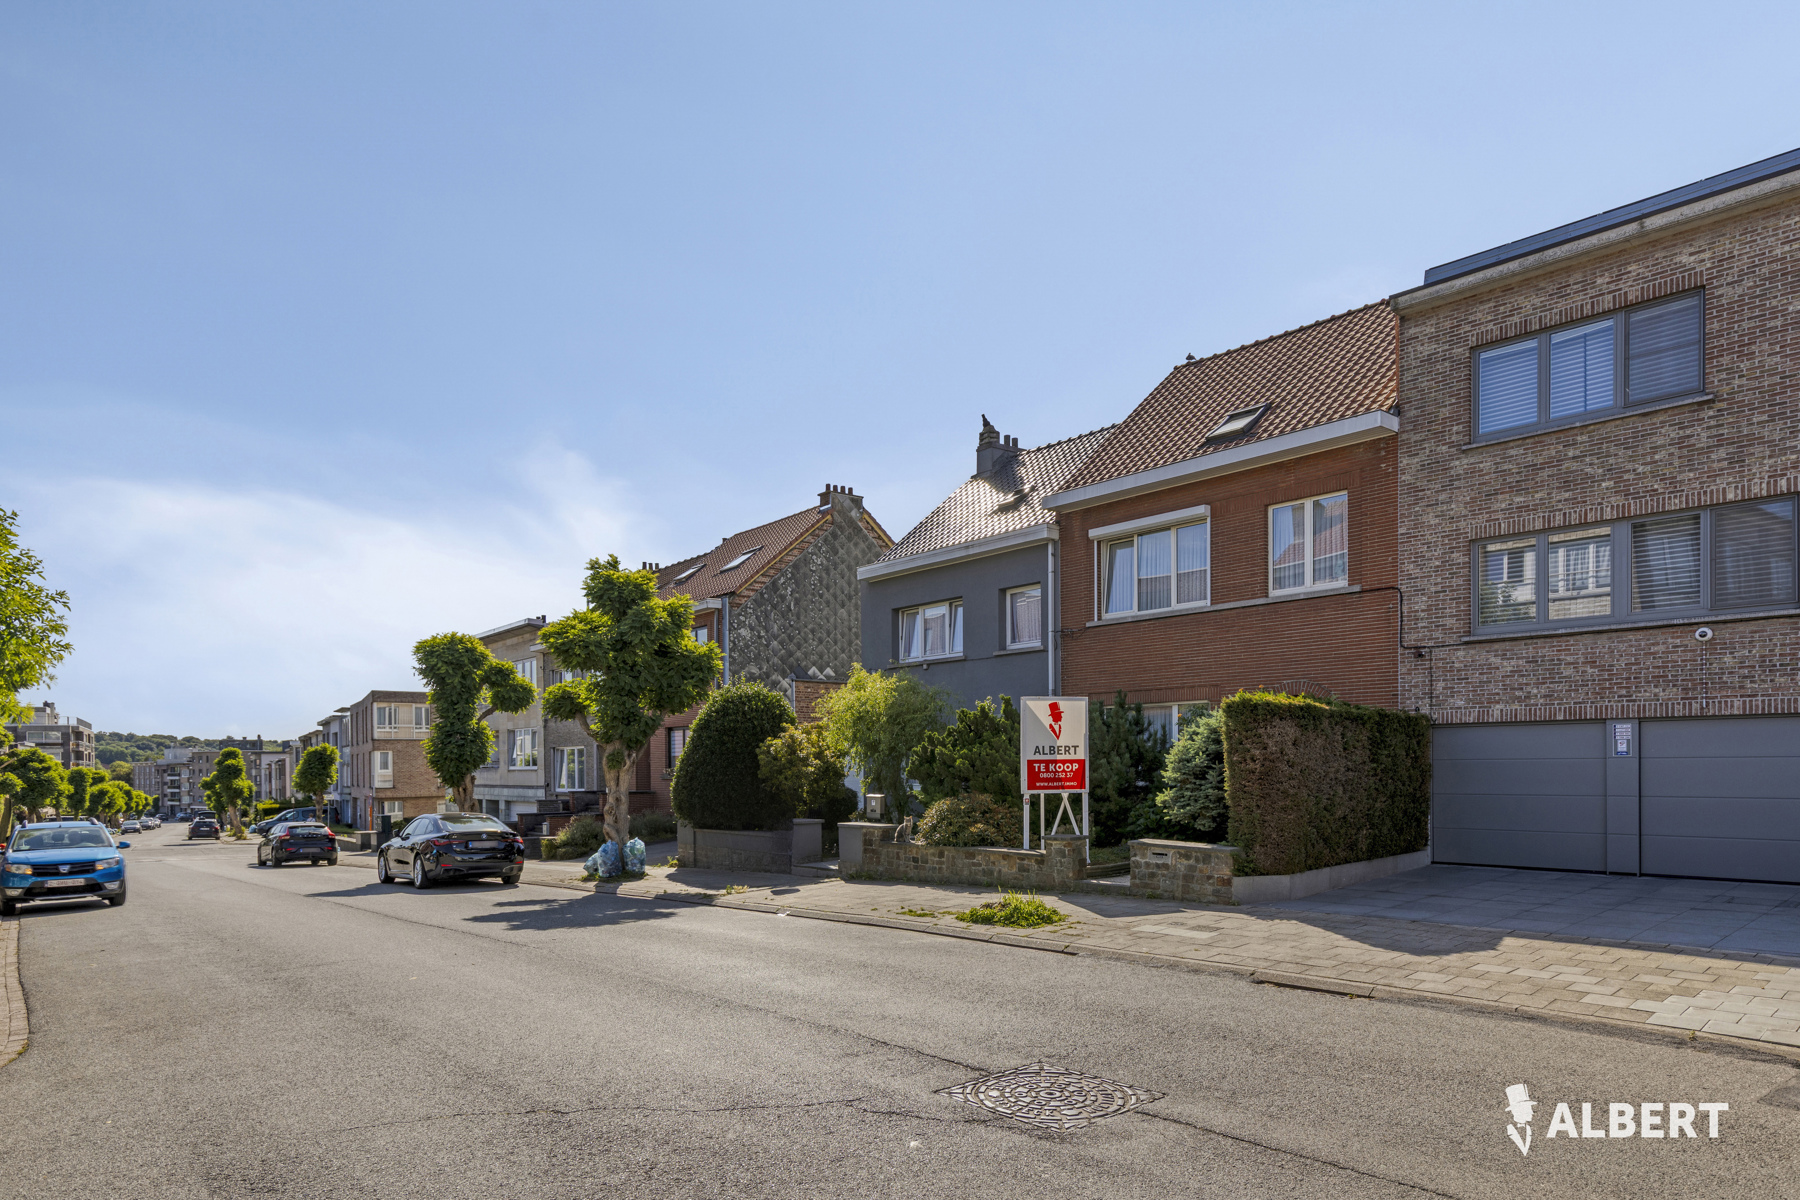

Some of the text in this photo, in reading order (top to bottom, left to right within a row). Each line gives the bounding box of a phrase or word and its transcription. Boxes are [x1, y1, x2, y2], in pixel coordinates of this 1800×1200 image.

[1033, 745, 1079, 755] ALBERT
[1033, 763, 1079, 772] TE KOOP
